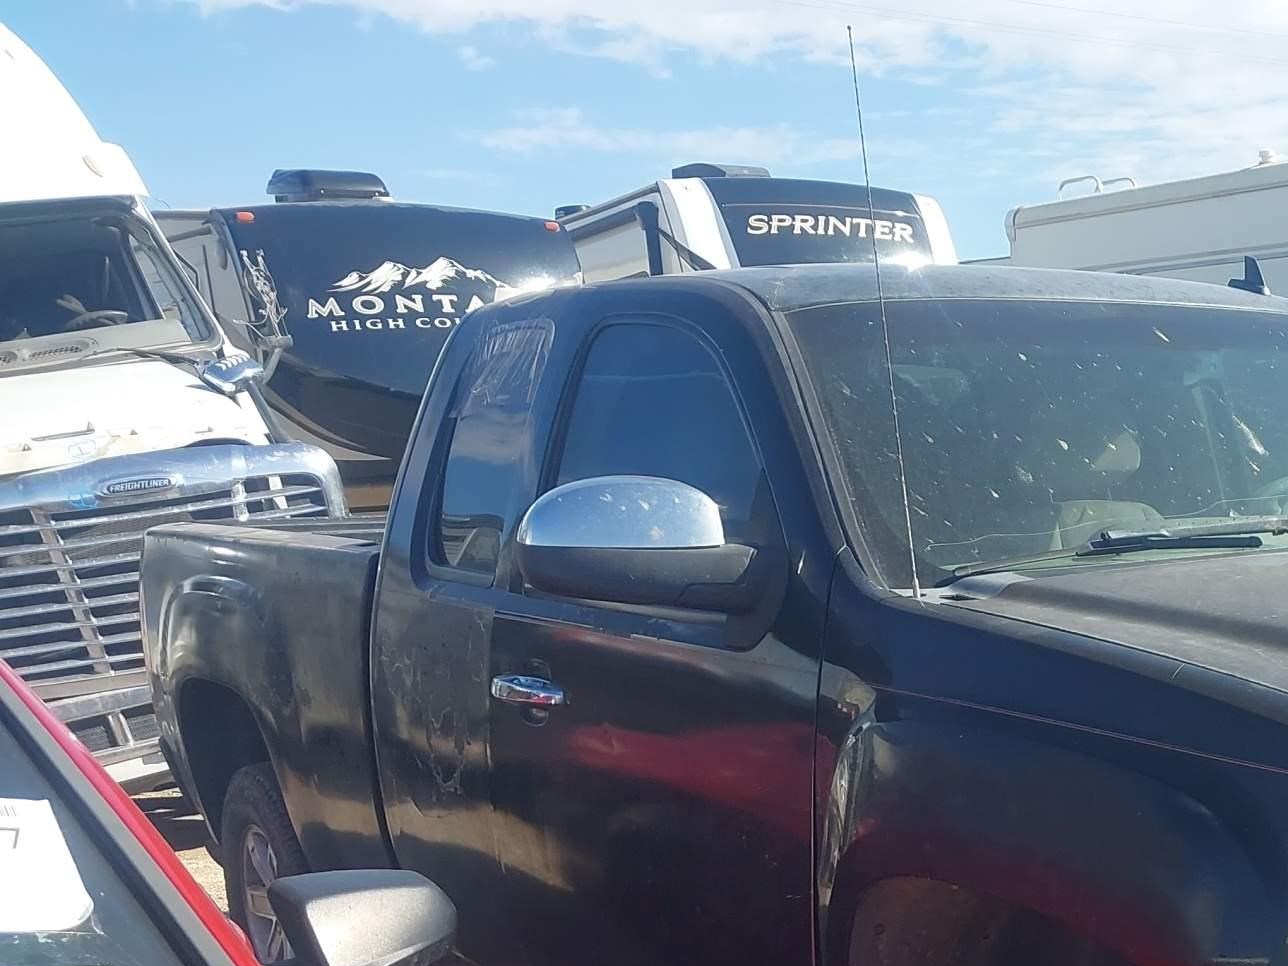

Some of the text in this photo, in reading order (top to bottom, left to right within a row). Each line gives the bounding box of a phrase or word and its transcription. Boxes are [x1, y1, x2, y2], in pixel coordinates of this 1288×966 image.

[747, 214, 914, 244] SPRINTER
[330, 317, 461, 331] HIGH CO
[110, 479, 169, 493] FREIGHTLINER
